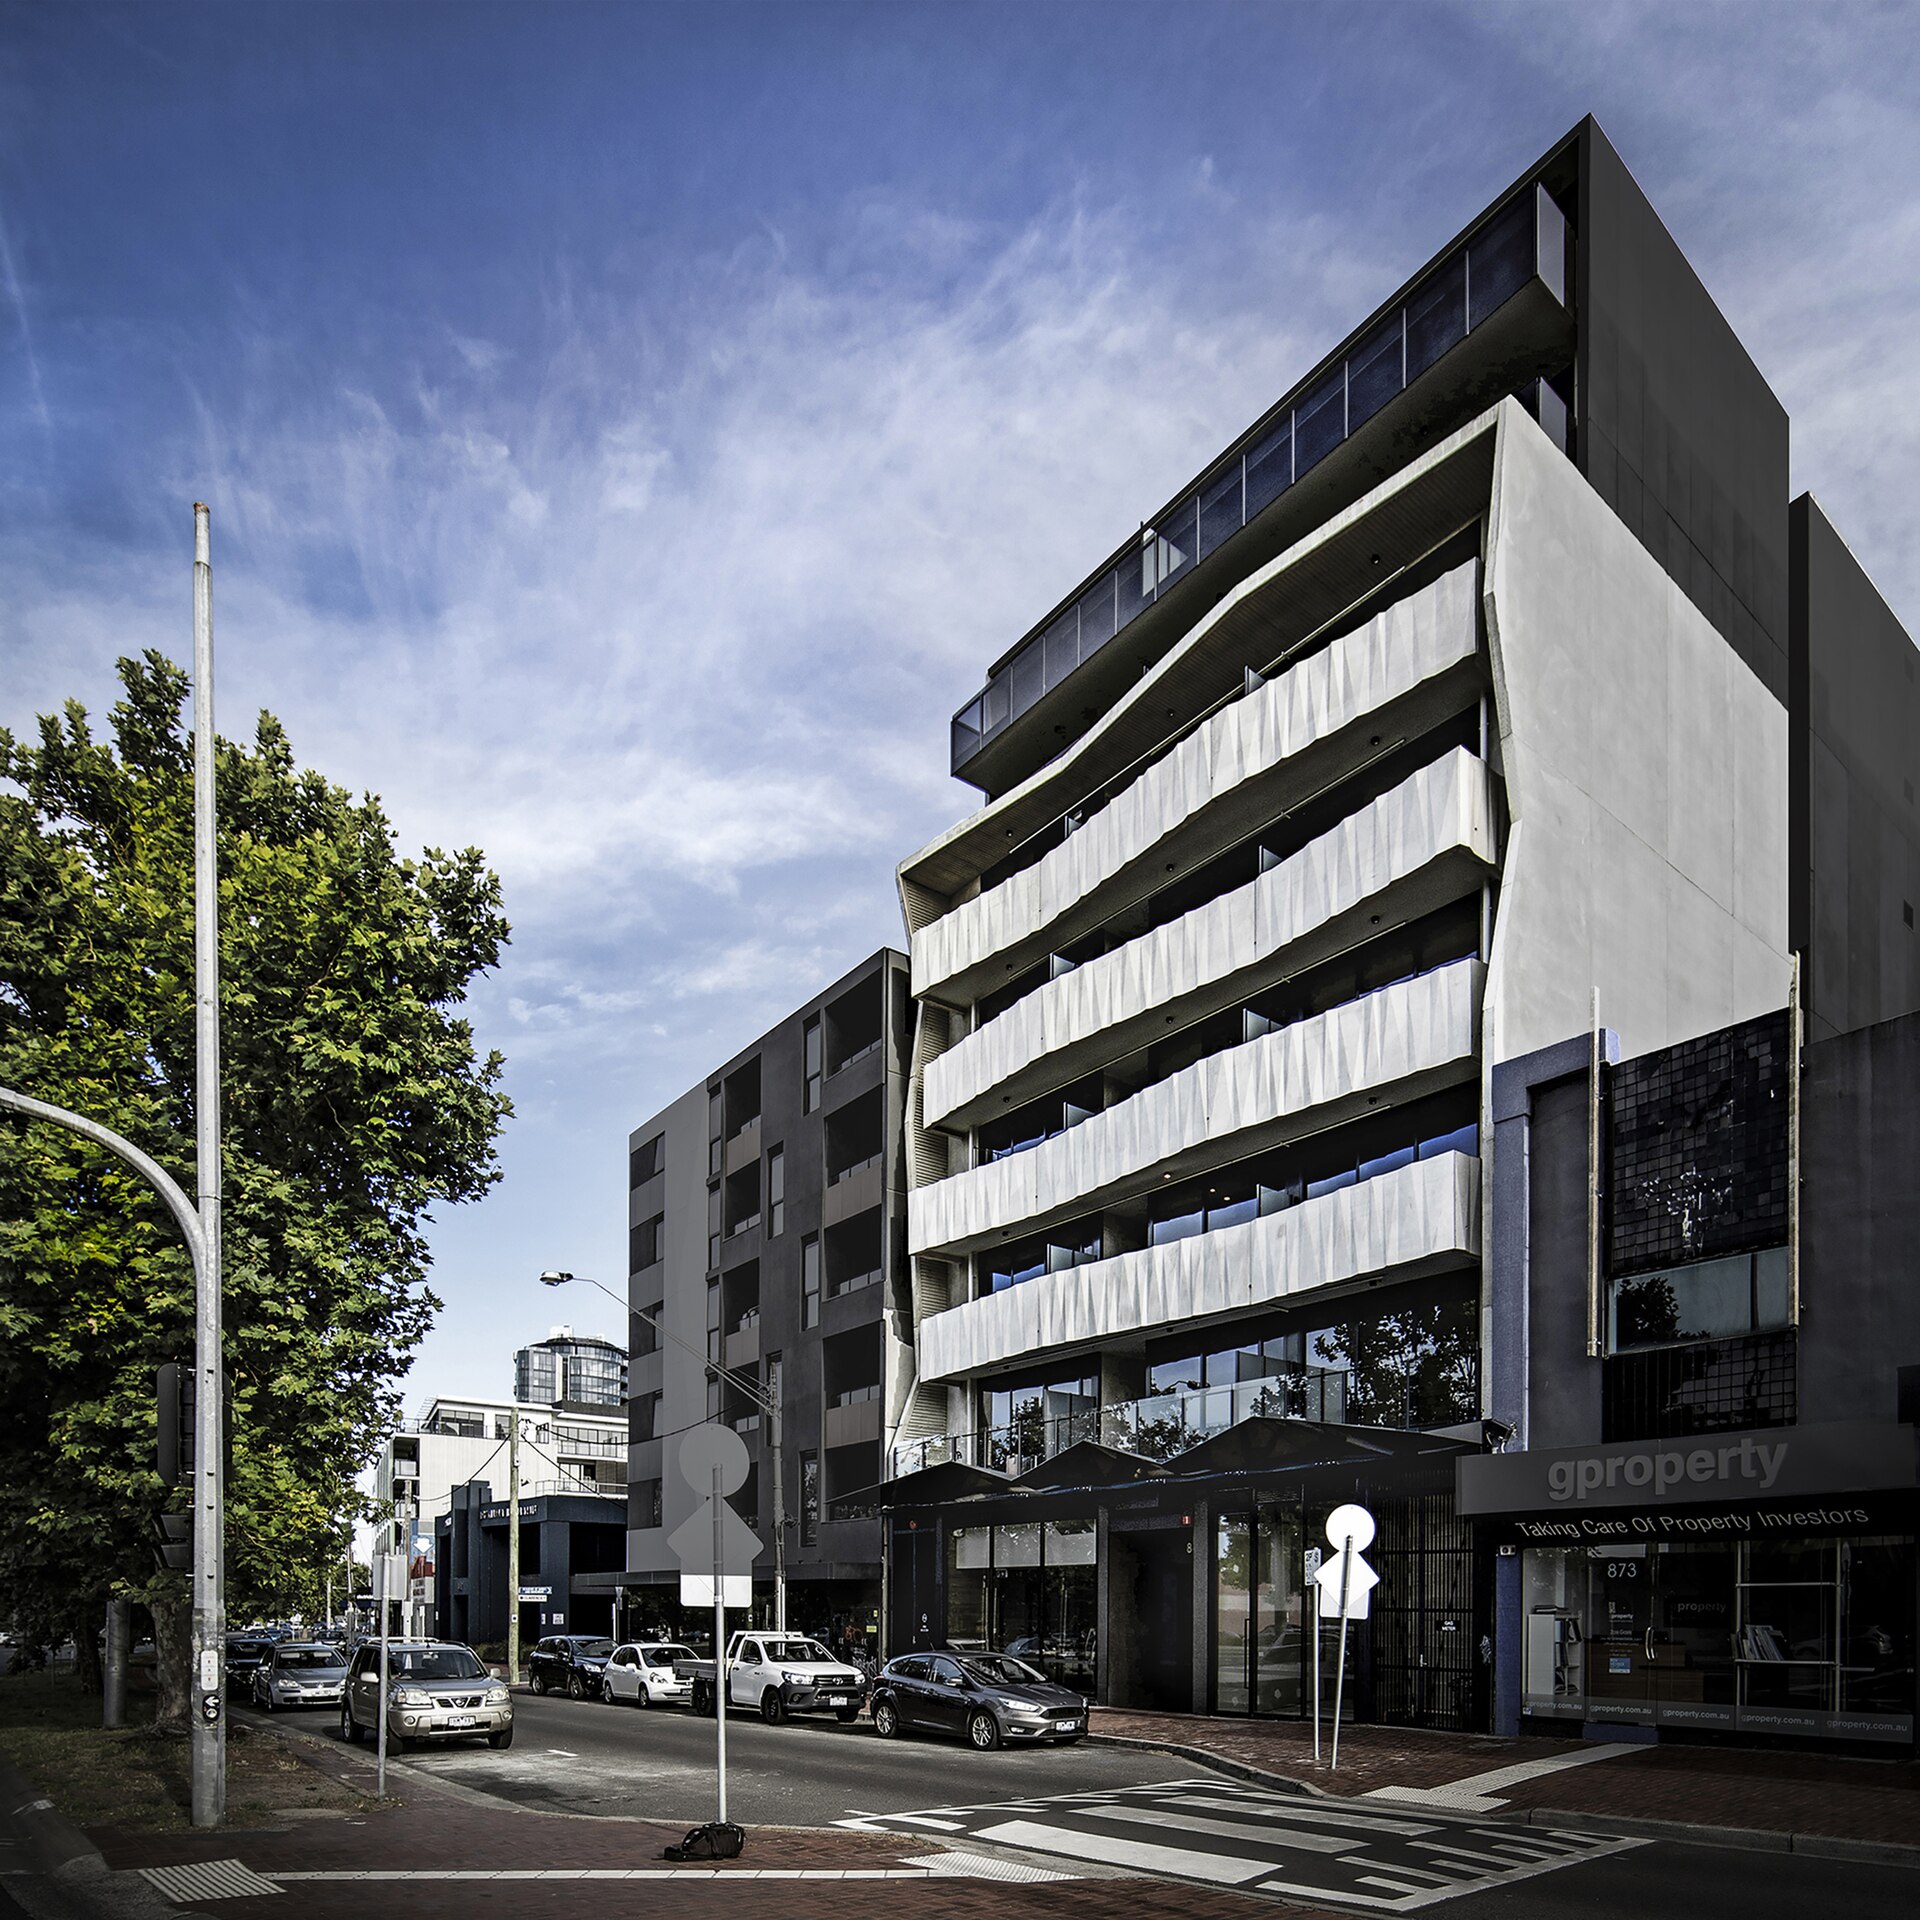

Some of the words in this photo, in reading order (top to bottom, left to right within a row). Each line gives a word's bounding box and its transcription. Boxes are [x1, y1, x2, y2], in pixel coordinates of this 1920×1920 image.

[1547, 1438, 1788, 1501] gproperty
[1515, 1521, 1581, 1538] Taking
[1581, 1519, 1628, 1535] Care
[1631, 1517, 1656, 1533] Of
[1659, 1514, 1751, 1533] Property
[1757, 1508, 1869, 1527] Investors
[1607, 1562, 1637, 1578] 873
[1589, 1704, 1652, 1715] gproperty.com.au
[1662, 1708, 1730, 1720] gproperty.com.au
[1740, 1713, 1816, 1726] gproperty.com.au
[1826, 1719, 1908, 1733] gproperty.com.au
